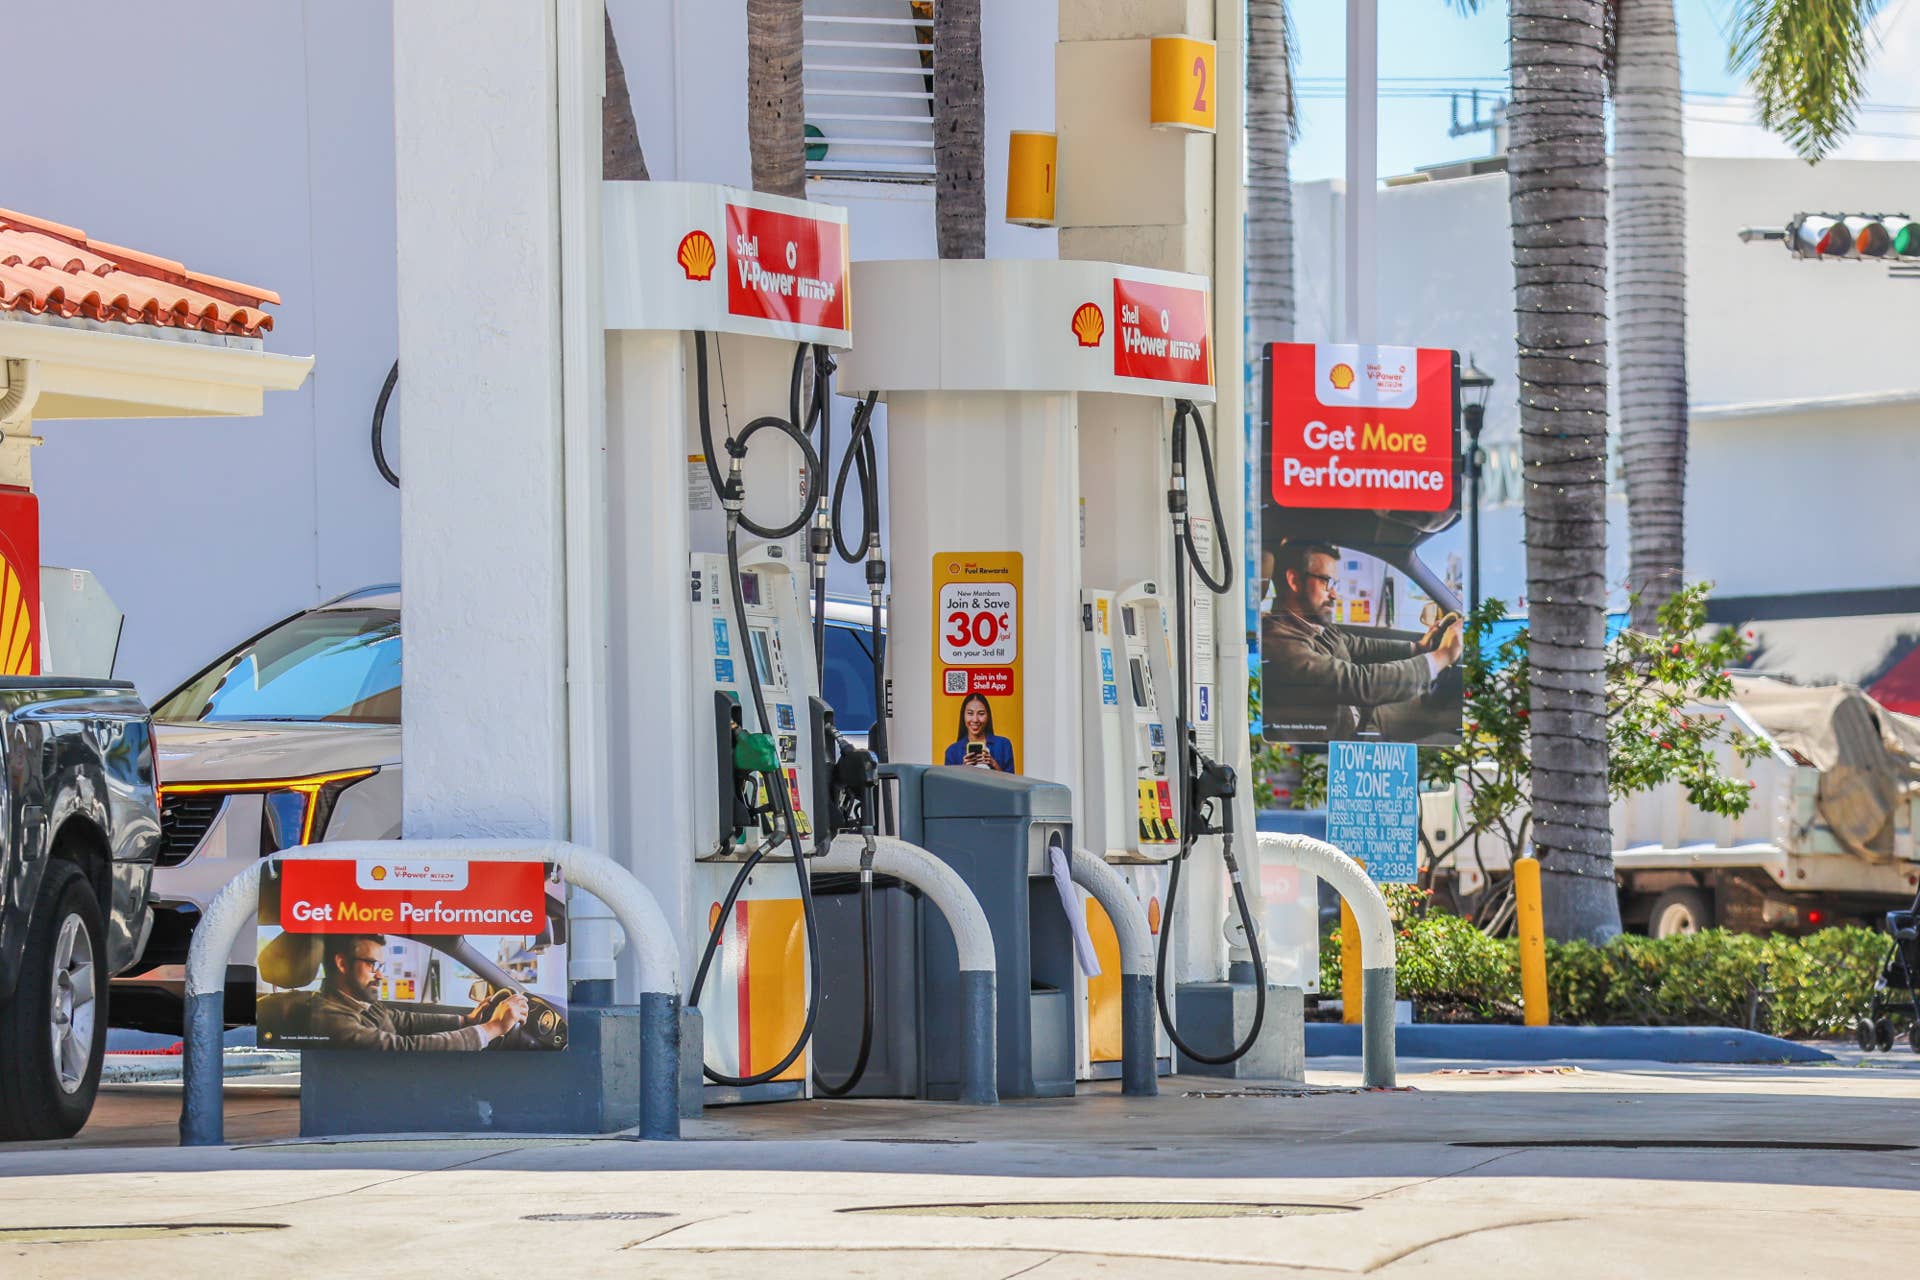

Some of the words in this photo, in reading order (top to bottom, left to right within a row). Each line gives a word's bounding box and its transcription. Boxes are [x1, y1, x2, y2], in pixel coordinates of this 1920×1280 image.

[1193, 56, 1206, 112] 2
[736, 233, 758, 257] Shell
[737, 259, 793, 296] V-Power
[1122, 304, 1139, 324] Shell
[1122, 326, 1167, 357] V-Power
[1367, 371, 1402, 380] V-Power
[1303, 420, 1355, 450] Get
[1361, 423, 1427, 453] More
[1283, 455, 1444, 491] Performance
[973, 589, 1001, 597] Members
[947, 598, 969, 609] Join
[972, 598, 980, 609] &
[984, 598, 1010, 609] Save
[996, 648, 1005, 656] fill
[973, 673, 988, 681] Join
[973, 681, 990, 690] Shell
[991, 682, 1006, 691] App
[1338, 743, 1407, 771] TOW-AWAY
[1333, 770, 1345, 783] 24
[1402, 772, 1409, 784] 7
[1331, 784, 1348, 798] HRS
[1355, 771, 1391, 798] ZONE
[1396, 785, 1414, 799] DAYS
[1332, 799, 1372, 812] UNAUTHORIZED
[1374, 800, 1402, 812] VEHICLES
[1404, 801, 1413, 813] OR
[1329, 812, 1355, 825] VESSELS
[1356, 813, 1367, 826] WILL
[1368, 813, 1377, 826] BE
[1379, 813, 1399, 826] TOWED
[1331, 826, 1338, 839] AT
[1340, 826, 1363, 839] OWNERS
[1364, 827, 1377, 840] RISK
[1386, 828, 1413, 841] EXPENSE
[1367, 841, 1396, 854] TOWING
[292, 900, 332, 922] Get
[337, 901, 394, 922] More
[400, 900, 533, 924] Performance
